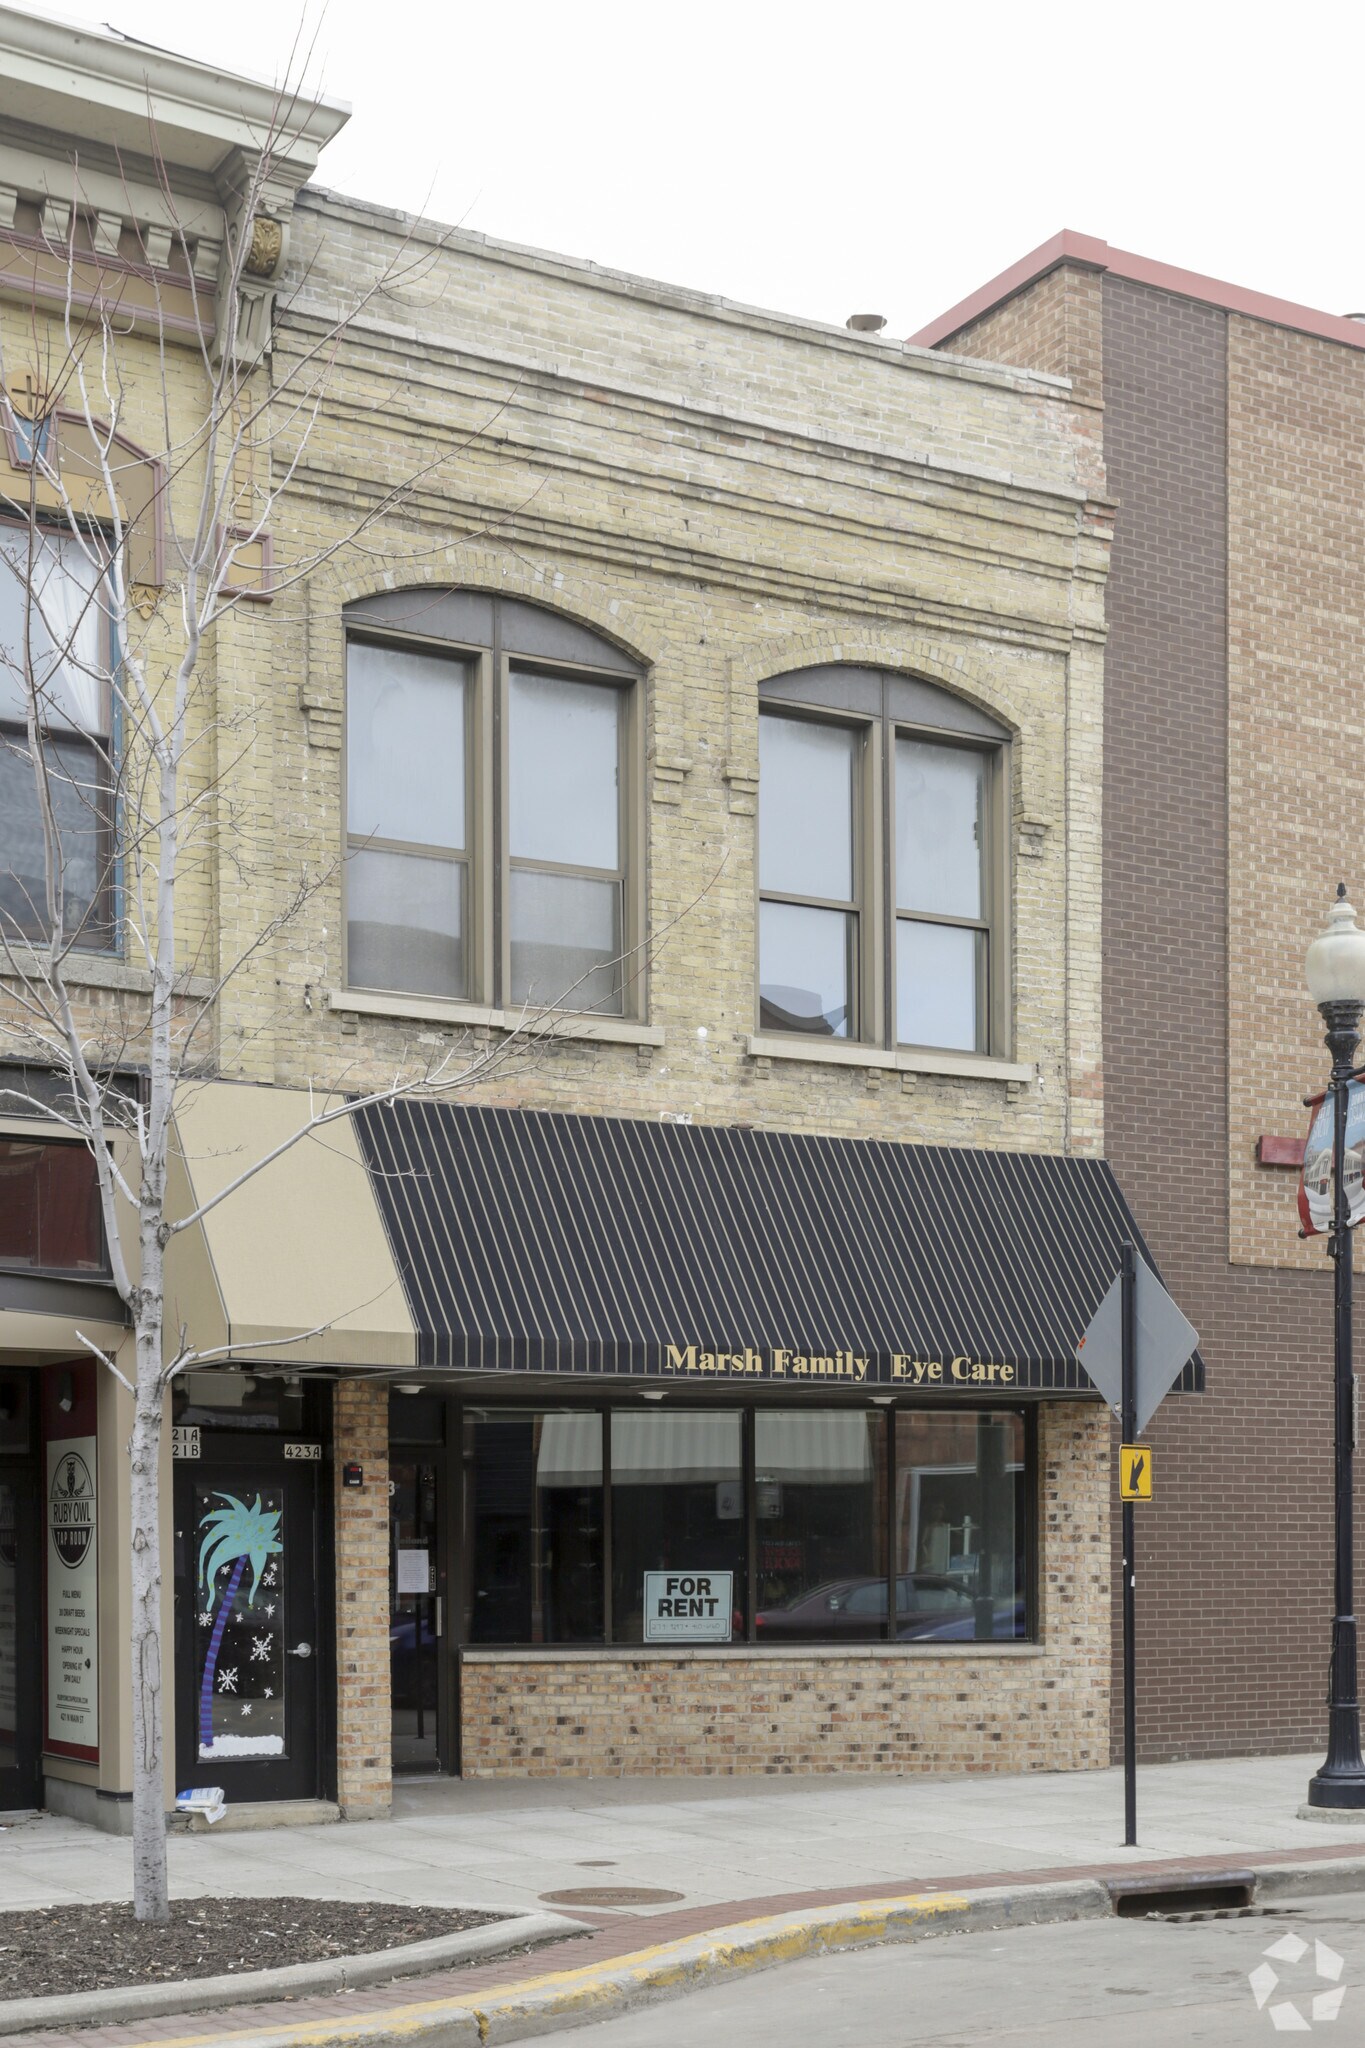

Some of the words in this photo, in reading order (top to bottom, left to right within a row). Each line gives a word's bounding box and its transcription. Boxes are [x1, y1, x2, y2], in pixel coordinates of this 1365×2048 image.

[664, 1344, 763, 1373] Marsh
[770, 1348, 871, 1381] Family
[890, 1354, 943, 1384] Eye
[950, 1356, 1015, 1382] Care
[172, 1429, 199, 1441] 21A
[172, 1444, 199, 1457] 21B
[285, 1446, 320, 1458] 423A
[53, 1502, 72, 1523] RUBY
[73, 1501, 91, 1522] OWL
[57, 1531, 68, 1546] TAP
[69, 1530, 87, 1546] ROOM
[666, 1577, 711, 1596] FOR
[62, 1590, 71, 1599] FULL
[71, 1590, 82, 1599] MENU
[63, 1608, 75, 1617] DRAFT
[657, 1598, 719, 1617] RENT
[74, 1627, 90, 1637] SPECIALS
[61, 1645, 73, 1655] HAPPY
[73, 1646, 84, 1656] HOUR
